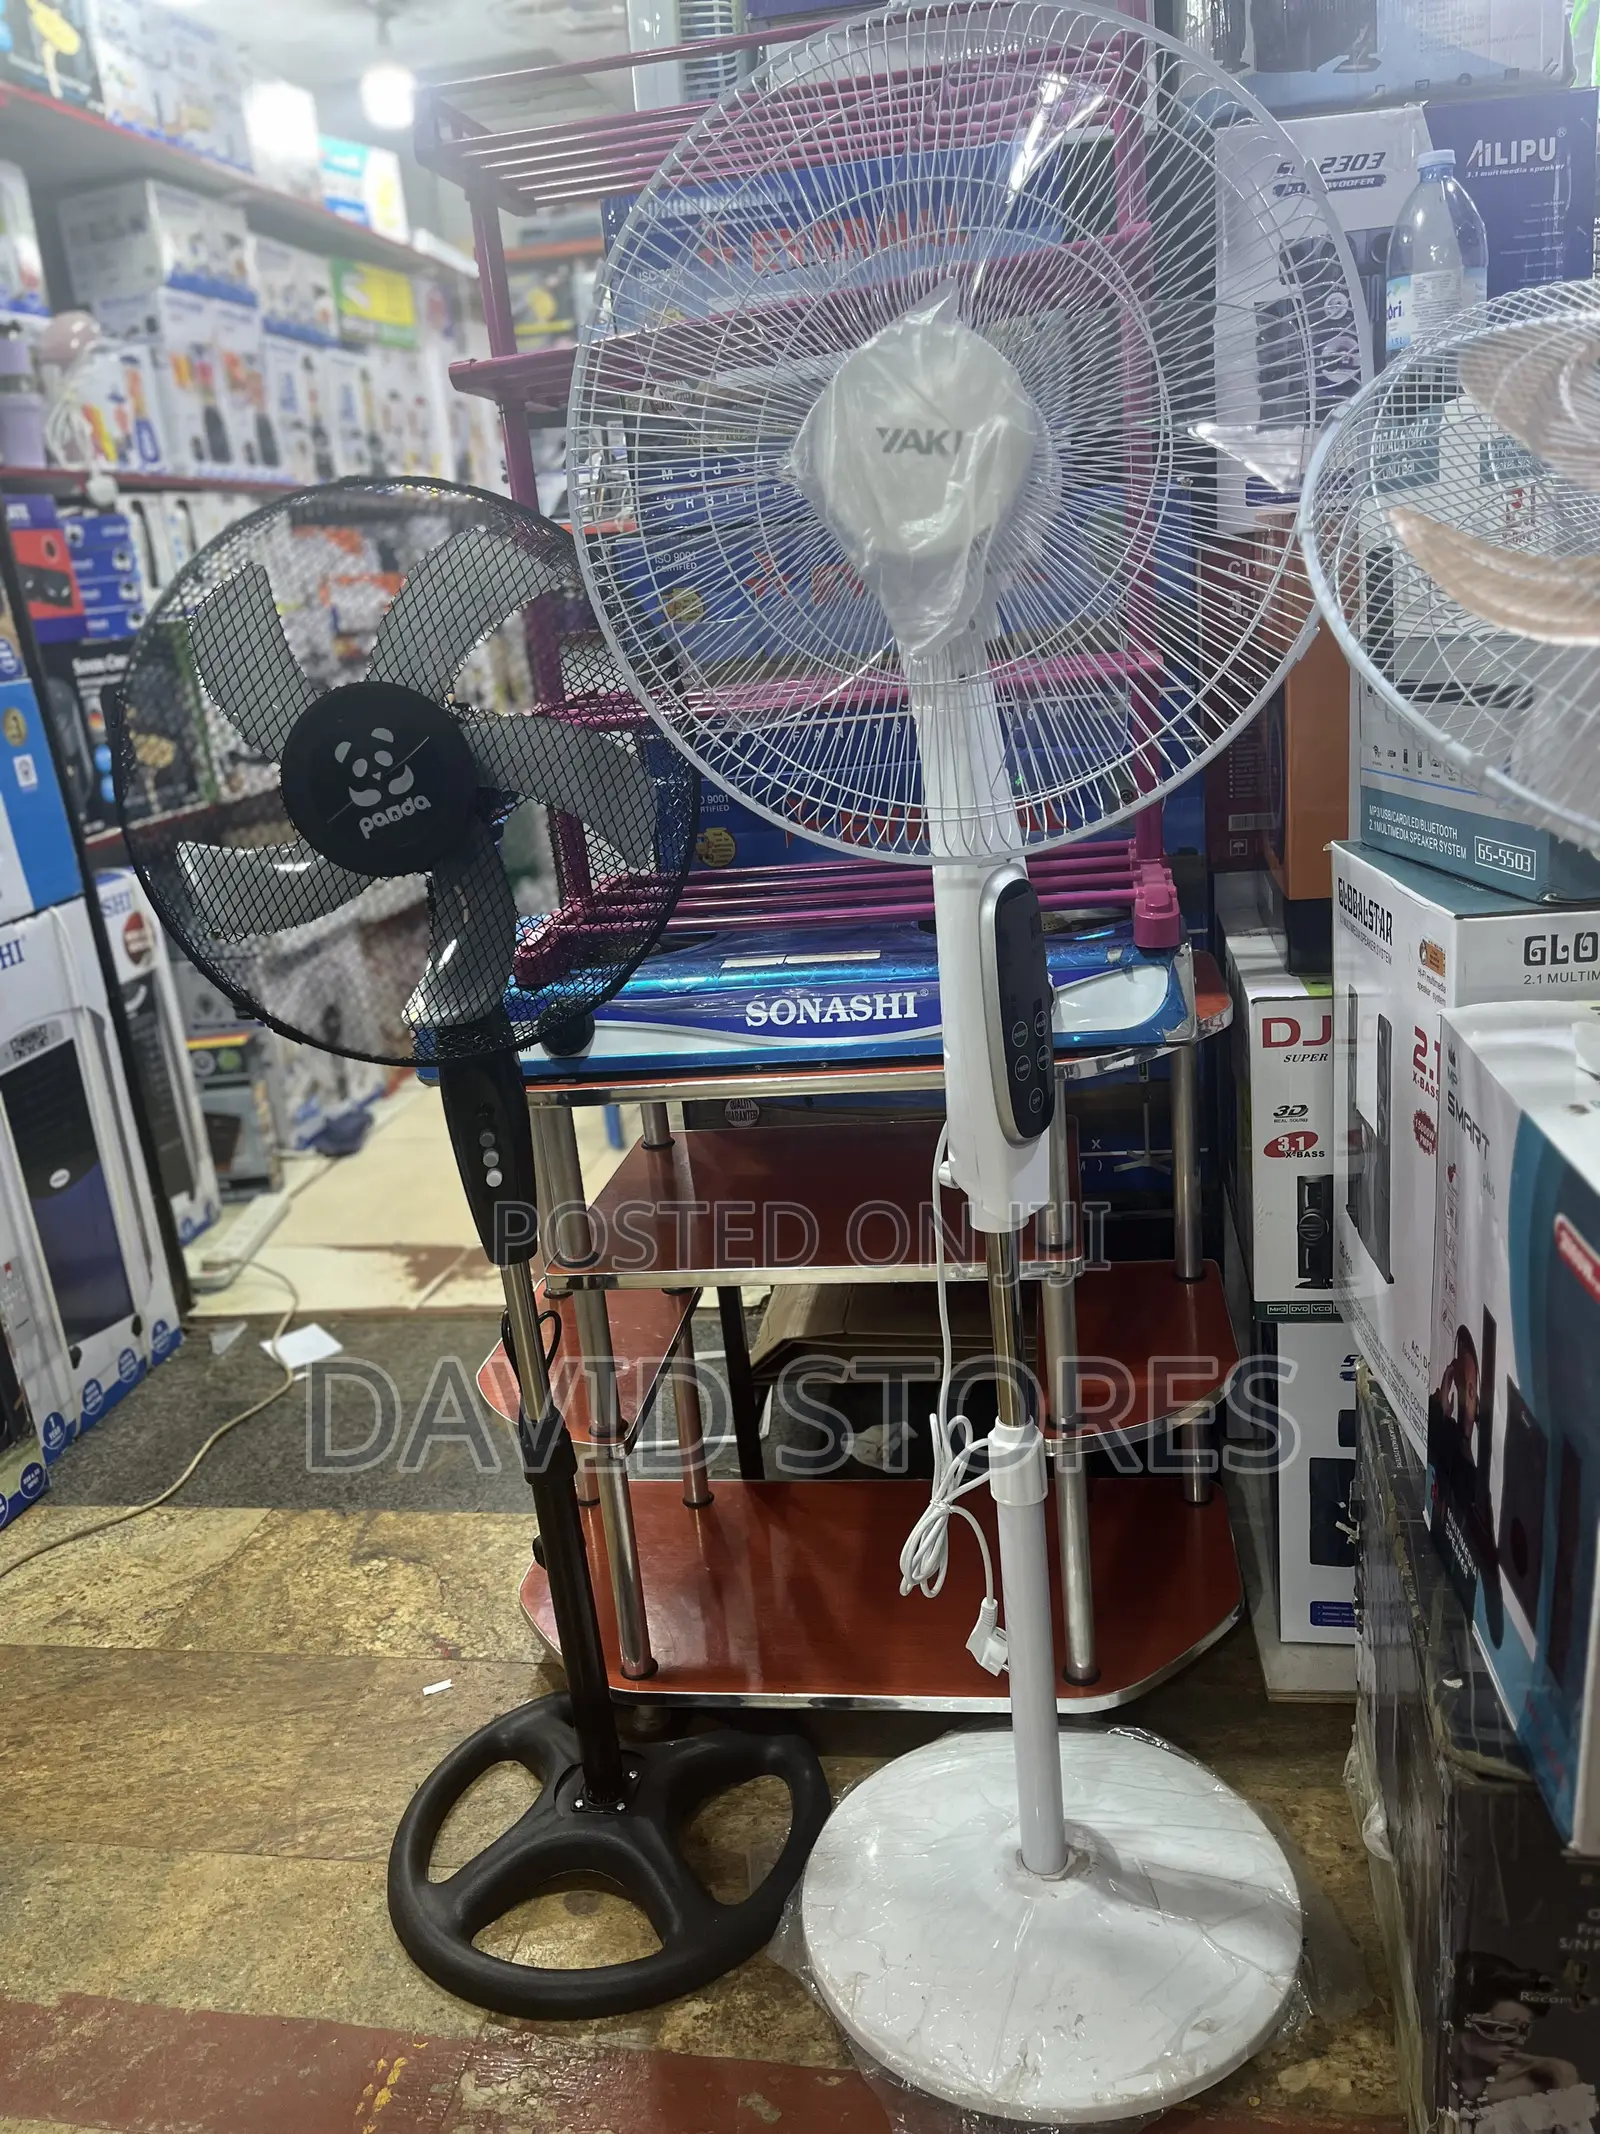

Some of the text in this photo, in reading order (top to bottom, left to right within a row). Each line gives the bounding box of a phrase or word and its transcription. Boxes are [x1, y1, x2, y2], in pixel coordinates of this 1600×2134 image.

[1466, 137, 1556, 168] AILIPU
[1480, 167, 1527, 178] multimedia
[1529, 163, 1565, 174] speaker
[707, 793, 729, 804] 9001
[359, 795, 432, 840] panda
[1438, 841, 1467, 860] SYSTEM
[1338, 876, 1393, 947] GLOBALSTAR
[1523, 974, 1543, 985] 2.1
[745, 991, 918, 1027] SONASHI
[1262, 1015, 1332, 1049] DJ
[1283, 1052, 1329, 1063] SUPER
[1447, 1090, 1490, 1160] SMART
[1277, 1136, 1305, 1152] 3.1
[1285, 1150, 1325, 1159] X-BASS
[1445, 1522, 1468, 1579] SPEAKER
[1447, 1507, 1477, 1580] MULTIMEDIA
